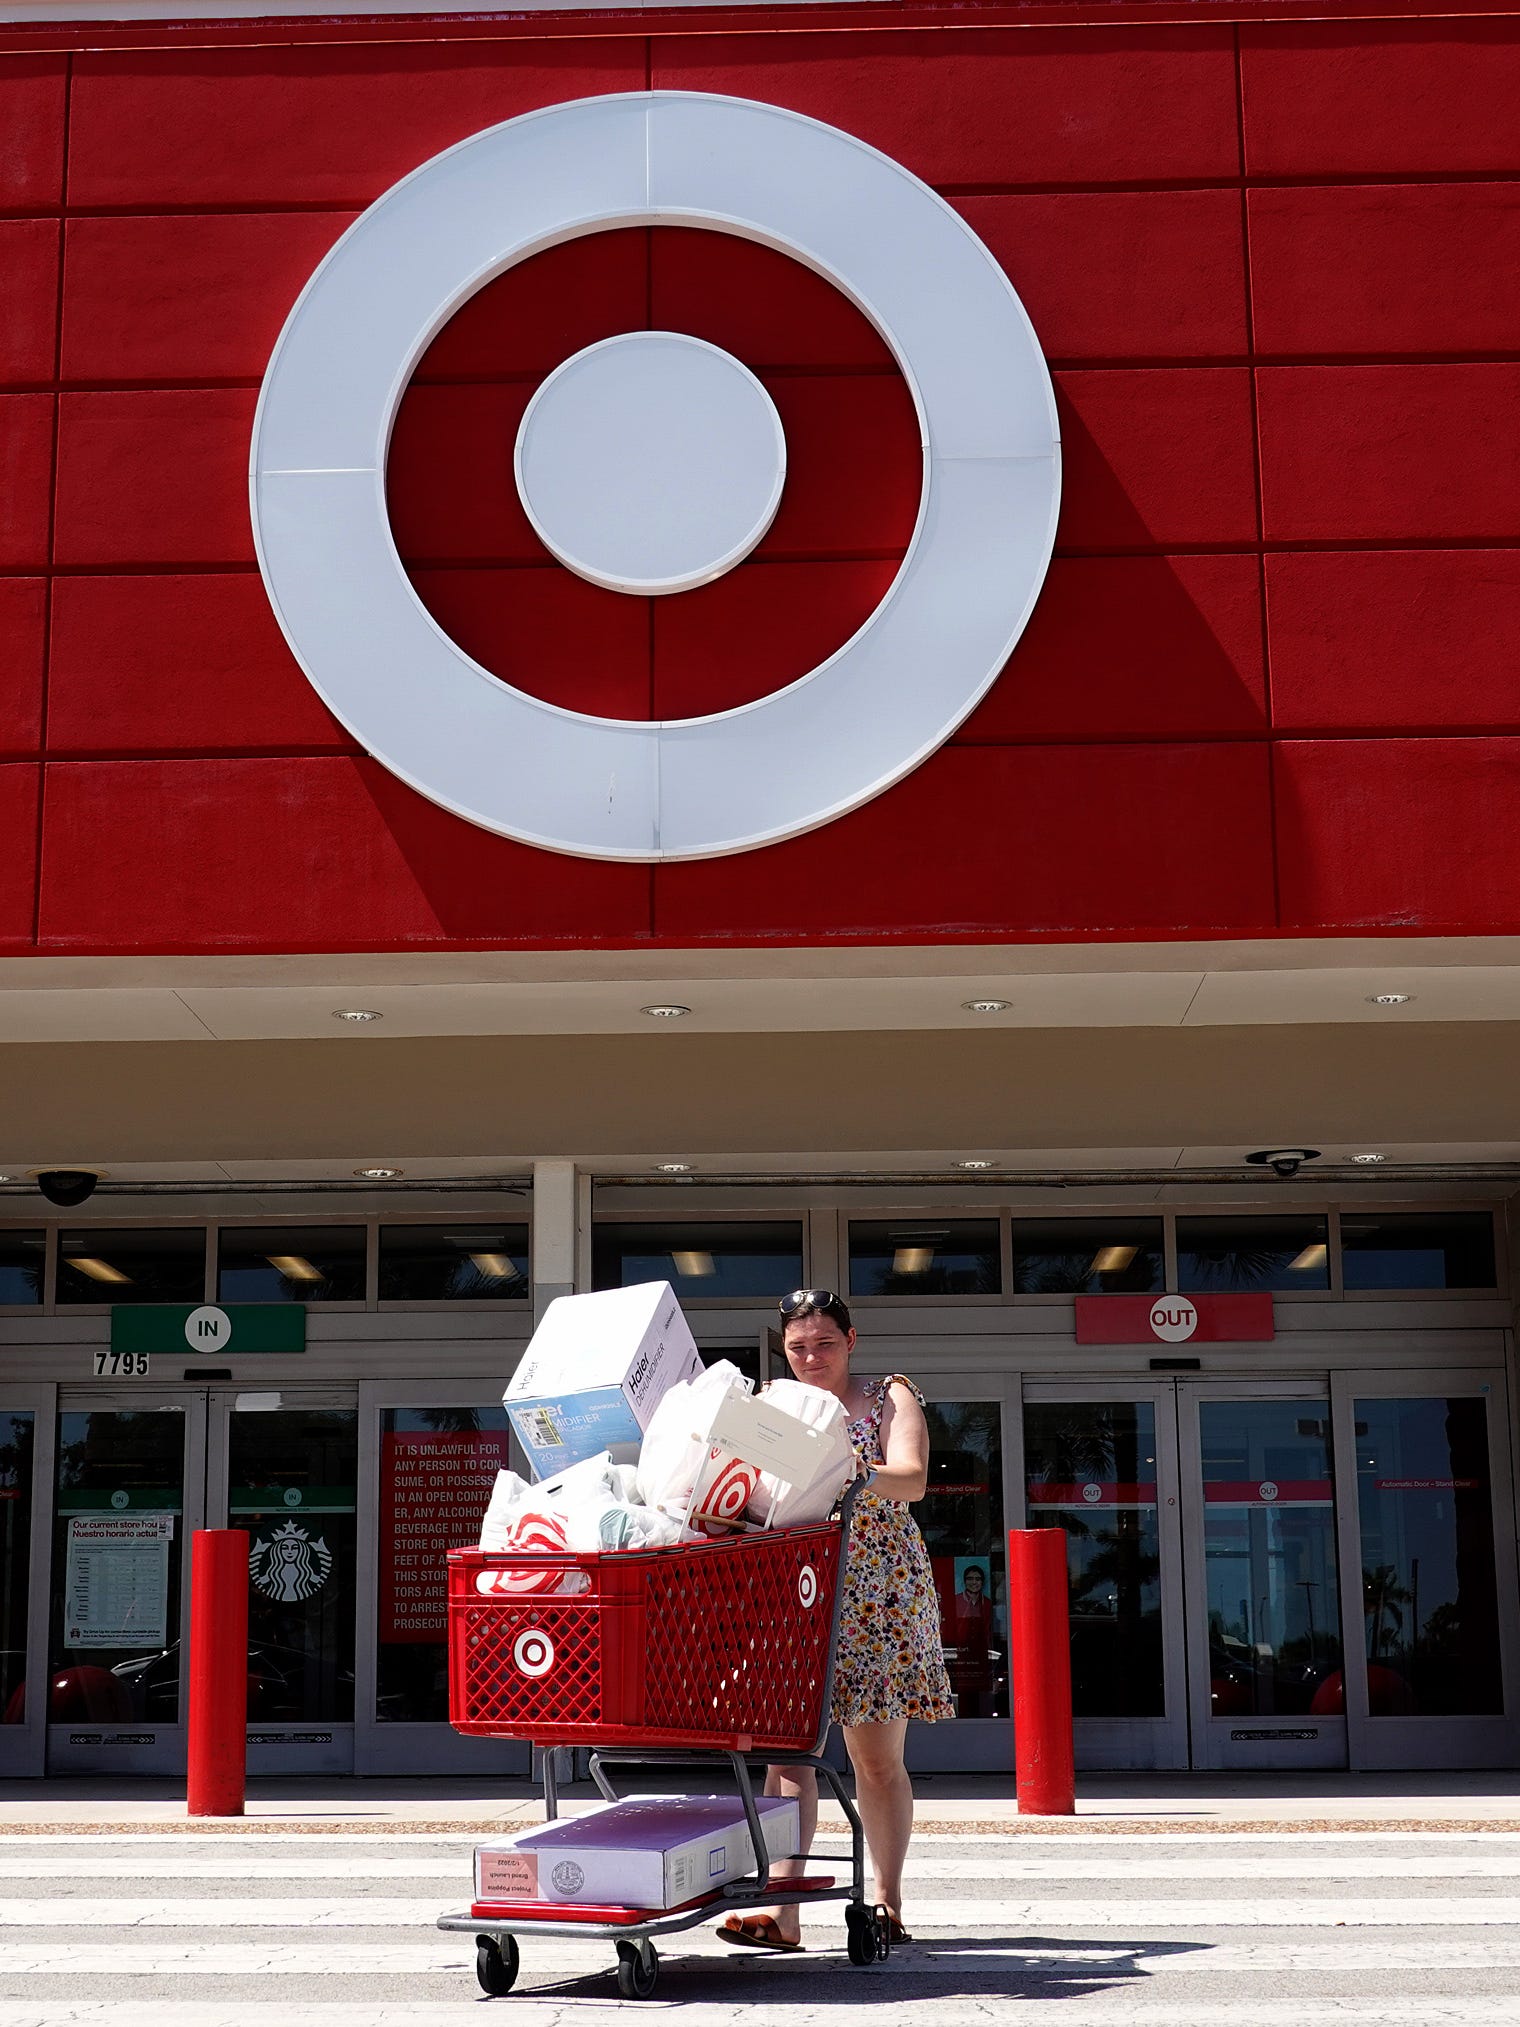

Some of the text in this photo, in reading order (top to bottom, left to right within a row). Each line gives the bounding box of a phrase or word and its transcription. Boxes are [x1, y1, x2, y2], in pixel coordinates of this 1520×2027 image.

[1151, 1308, 1194, 1327] OUT
[198, 1320, 219, 1337] IN
[95, 1352, 149, 1375] 7795
[628, 1351, 650, 1395] Haier
[635, 1342, 666, 1407] DEHUMIDIFIER
[394, 1443, 500, 1456] IT IS UNLAWFUL FOR
[394, 1459, 507, 1472] ANY PERSON TO CON-
[394, 1476, 427, 1488] SUME,
[429, 1475, 444, 1487] OR
[1381, 1480, 1413, 1488] Automatic
[1414, 1480, 1430, 1488] Door
[288, 1493, 298, 1501] IN
[394, 1490, 491, 1503] IN AN OPEN CONTA
[1083, 1488, 1101, 1498] OUT
[1260, 1486, 1277, 1496] OUT
[115, 1495, 124, 1504] IN
[394, 1506, 488, 1520] ER, ANY ALCOHOL
[73, 1520, 88, 1529] Our
[89, 1520, 119, 1529] current
[119, 1521, 141, 1529] store
[142, 1520, 158, 1529] hou
[394, 1522, 482, 1534] BEVERAGE IN THI
[72, 1529, 158, 1538] Nuestro horario actua
[394, 1538, 481, 1550] STORE OR WITHI
[394, 1554, 419, 1566] FEET
[421, 1554, 436, 1565] OF
[394, 1570, 448, 1582] THIS STOR
[394, 1586, 446, 1598] TORS ARE
[394, 1602, 407, 1613] TO
[393, 1617, 448, 1629] PROSECUT
[489, 1872, 529, 1880] Brand Launch
[511, 1885, 532, 1893] Project
